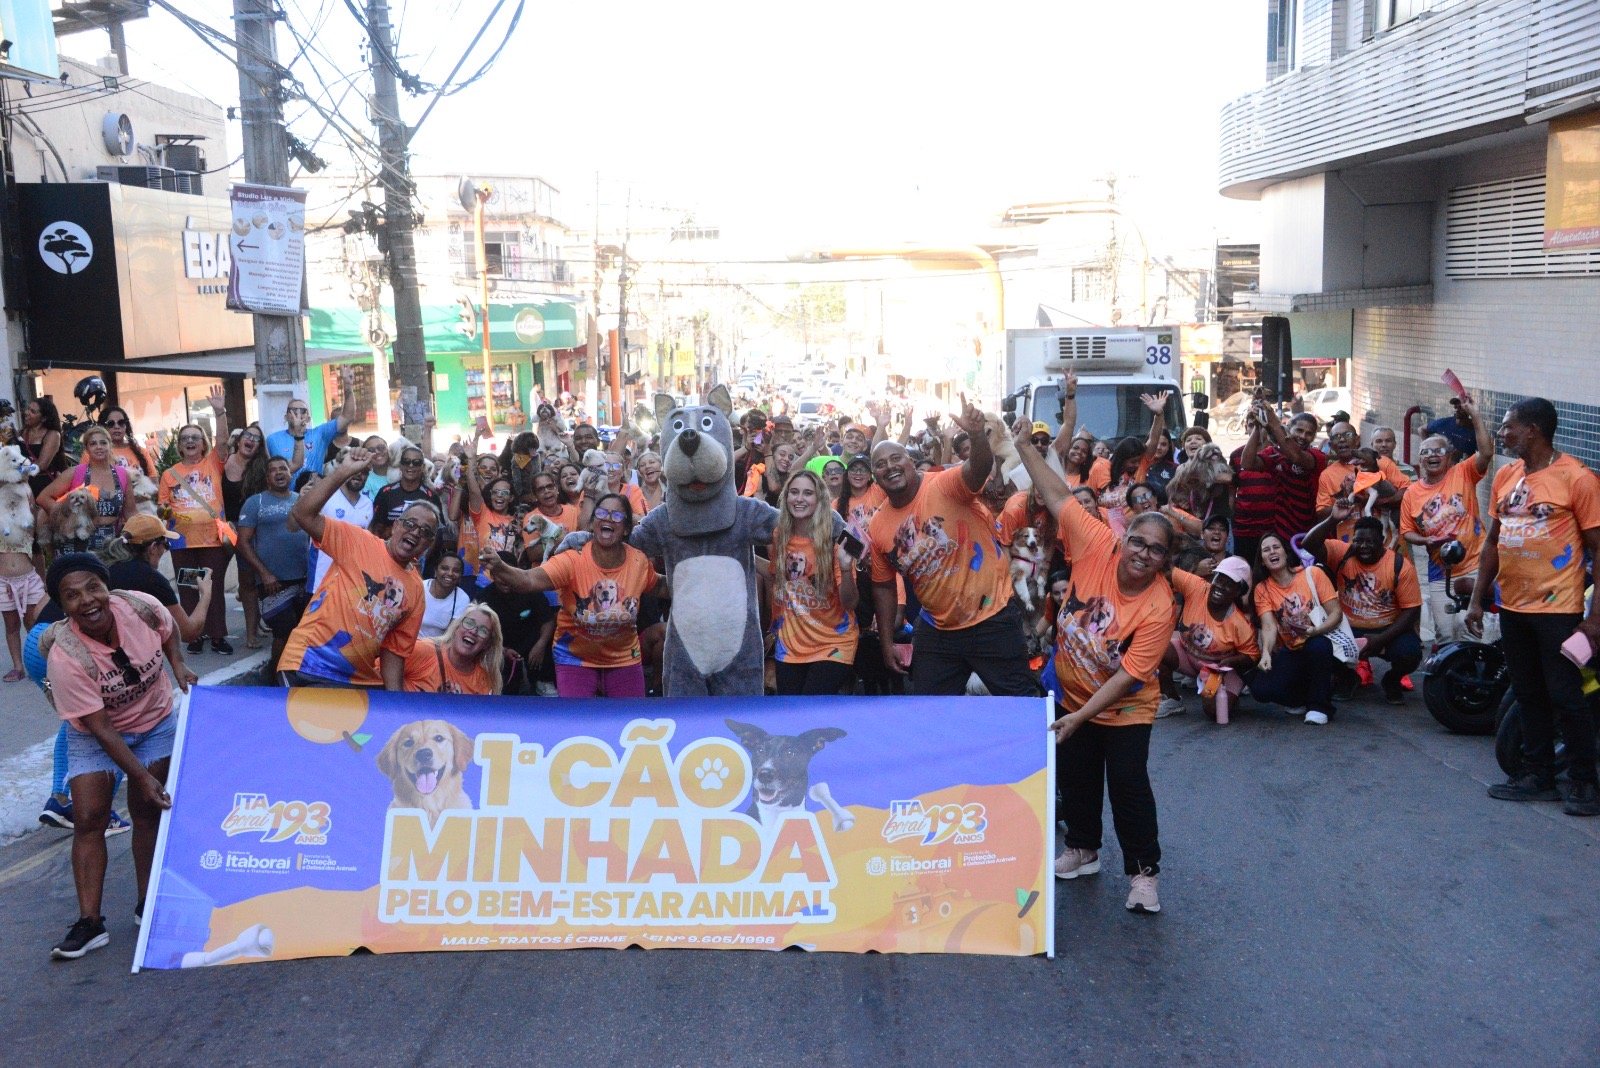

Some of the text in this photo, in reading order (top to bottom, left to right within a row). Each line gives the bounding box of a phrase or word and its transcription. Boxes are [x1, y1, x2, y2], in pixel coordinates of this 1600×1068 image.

[238, 192, 259, 200] Studio
[1549, 228, 1600, 245] Alimentação
[182, 216, 231, 278] ÉBA
[1146, 346, 1171, 365] 38
[100, 668, 125, 682] Ama
[549, 725, 747, 808] CÃO
[236, 795, 267, 810] ITA
[892, 801, 923, 816] ITA
[263, 802, 329, 841] 193
[922, 804, 985, 844] 193
[297, 835, 326, 844] ANOS
[956, 834, 984, 843] ANOS
[388, 815, 831, 884] MINHADA
[303, 858, 337, 866] Proteção
[963, 853, 996, 862] Proteção
[386, 889, 829, 919] PELO BEM-ESTAR ANIMAL
[441, 936, 561, 945] MAUS-TRATOS
[564, 933, 573, 944] É
[576, 935, 628, 943] CRIME
[687, 933, 775, 944] 9.605/1998
